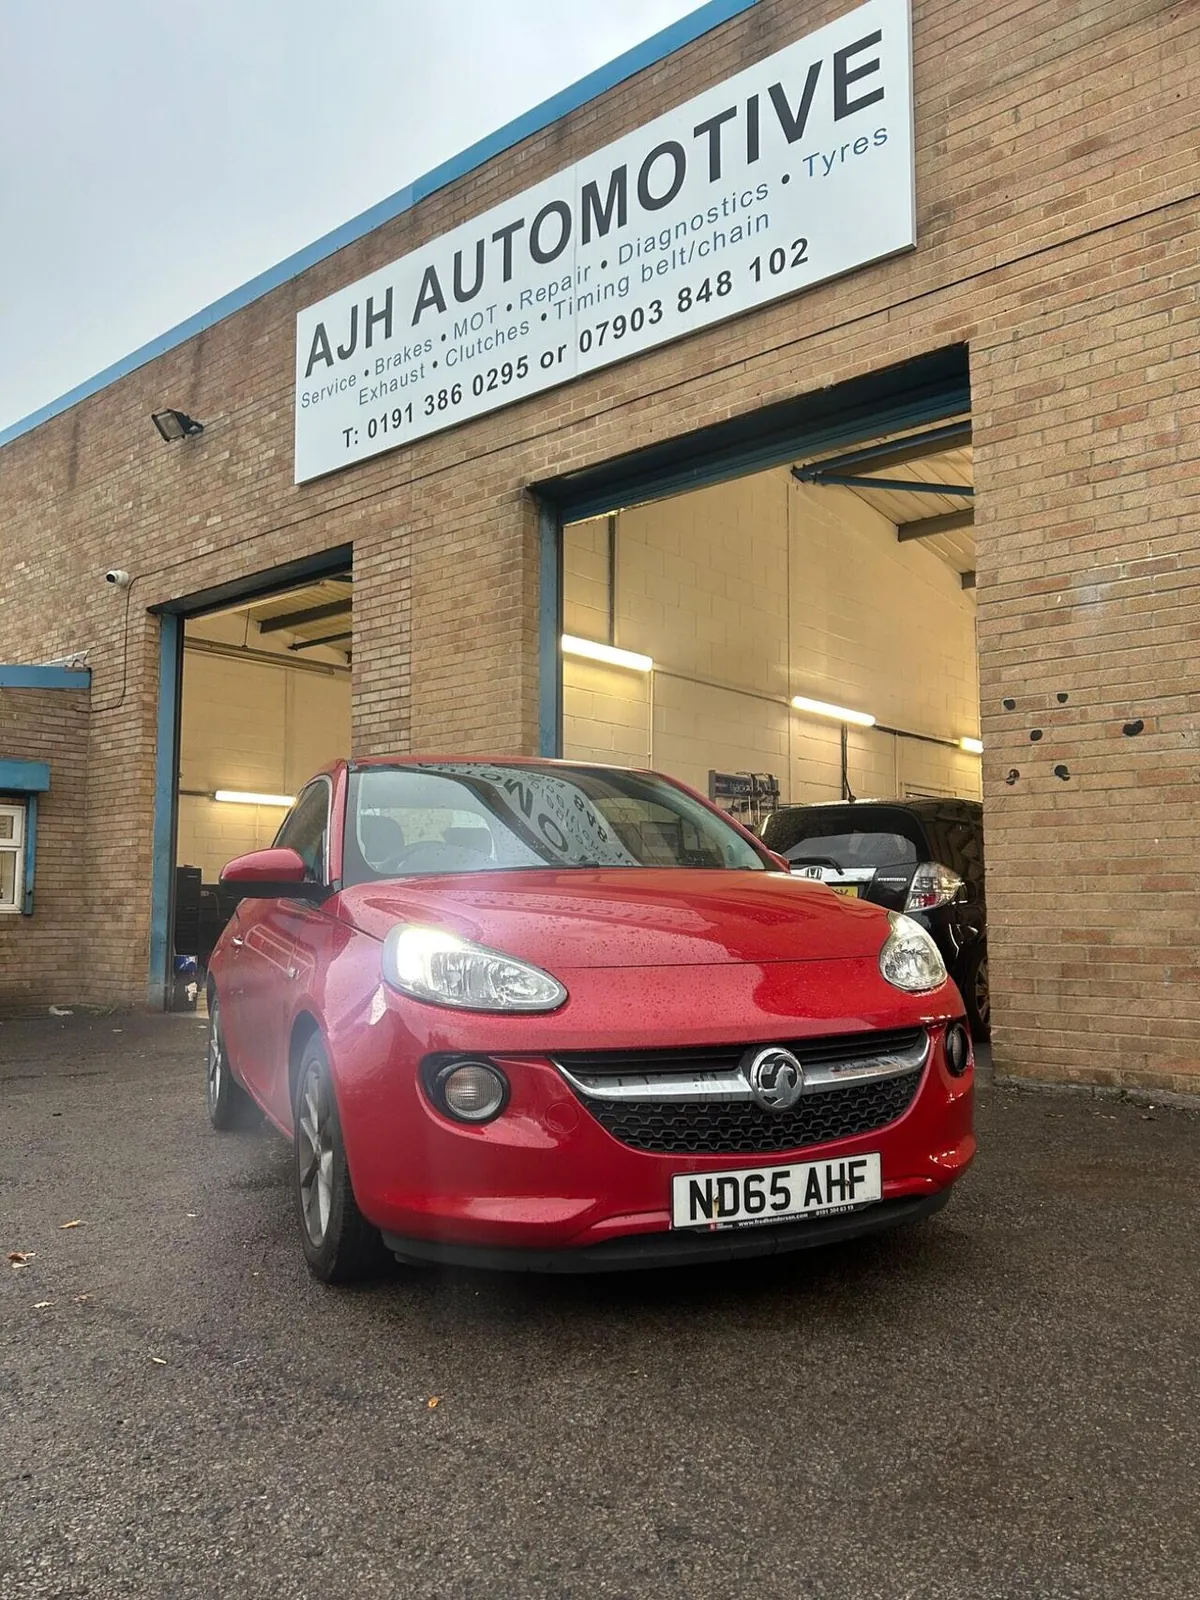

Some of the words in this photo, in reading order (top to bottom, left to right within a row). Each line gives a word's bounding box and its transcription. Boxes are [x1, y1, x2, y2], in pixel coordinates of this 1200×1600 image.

[301, 373, 357, 409] Service
[375, 339, 433, 376] Brakes
[454, 304, 498, 340] MOT
[519, 263, 591, 311] Repair
[618, 182, 769, 265] Diagnostics
[802, 126, 889, 178] Tyres
[305, 286, 394, 378] AJH
[411, 28, 885, 327] AUTOMOTIVE
[342, 426, 359, 449] T:
[368, 403, 414, 439] 0191
[424, 382, 463, 417] 386
[472, 355, 530, 397] 0295
[540, 343, 568, 370] or
[579, 299, 664, 354] 07903
[677, 269, 733, 314] 848
[749, 237, 810, 284] 102
[359, 364, 426, 406] Exhaust
[445, 319, 531, 368] Clutches
[554, 272, 631, 321] Timing
[641, 213, 770, 284] belt/chain
[689, 1170, 792, 1221] ND65
[803, 1159, 868, 1208] AHF
